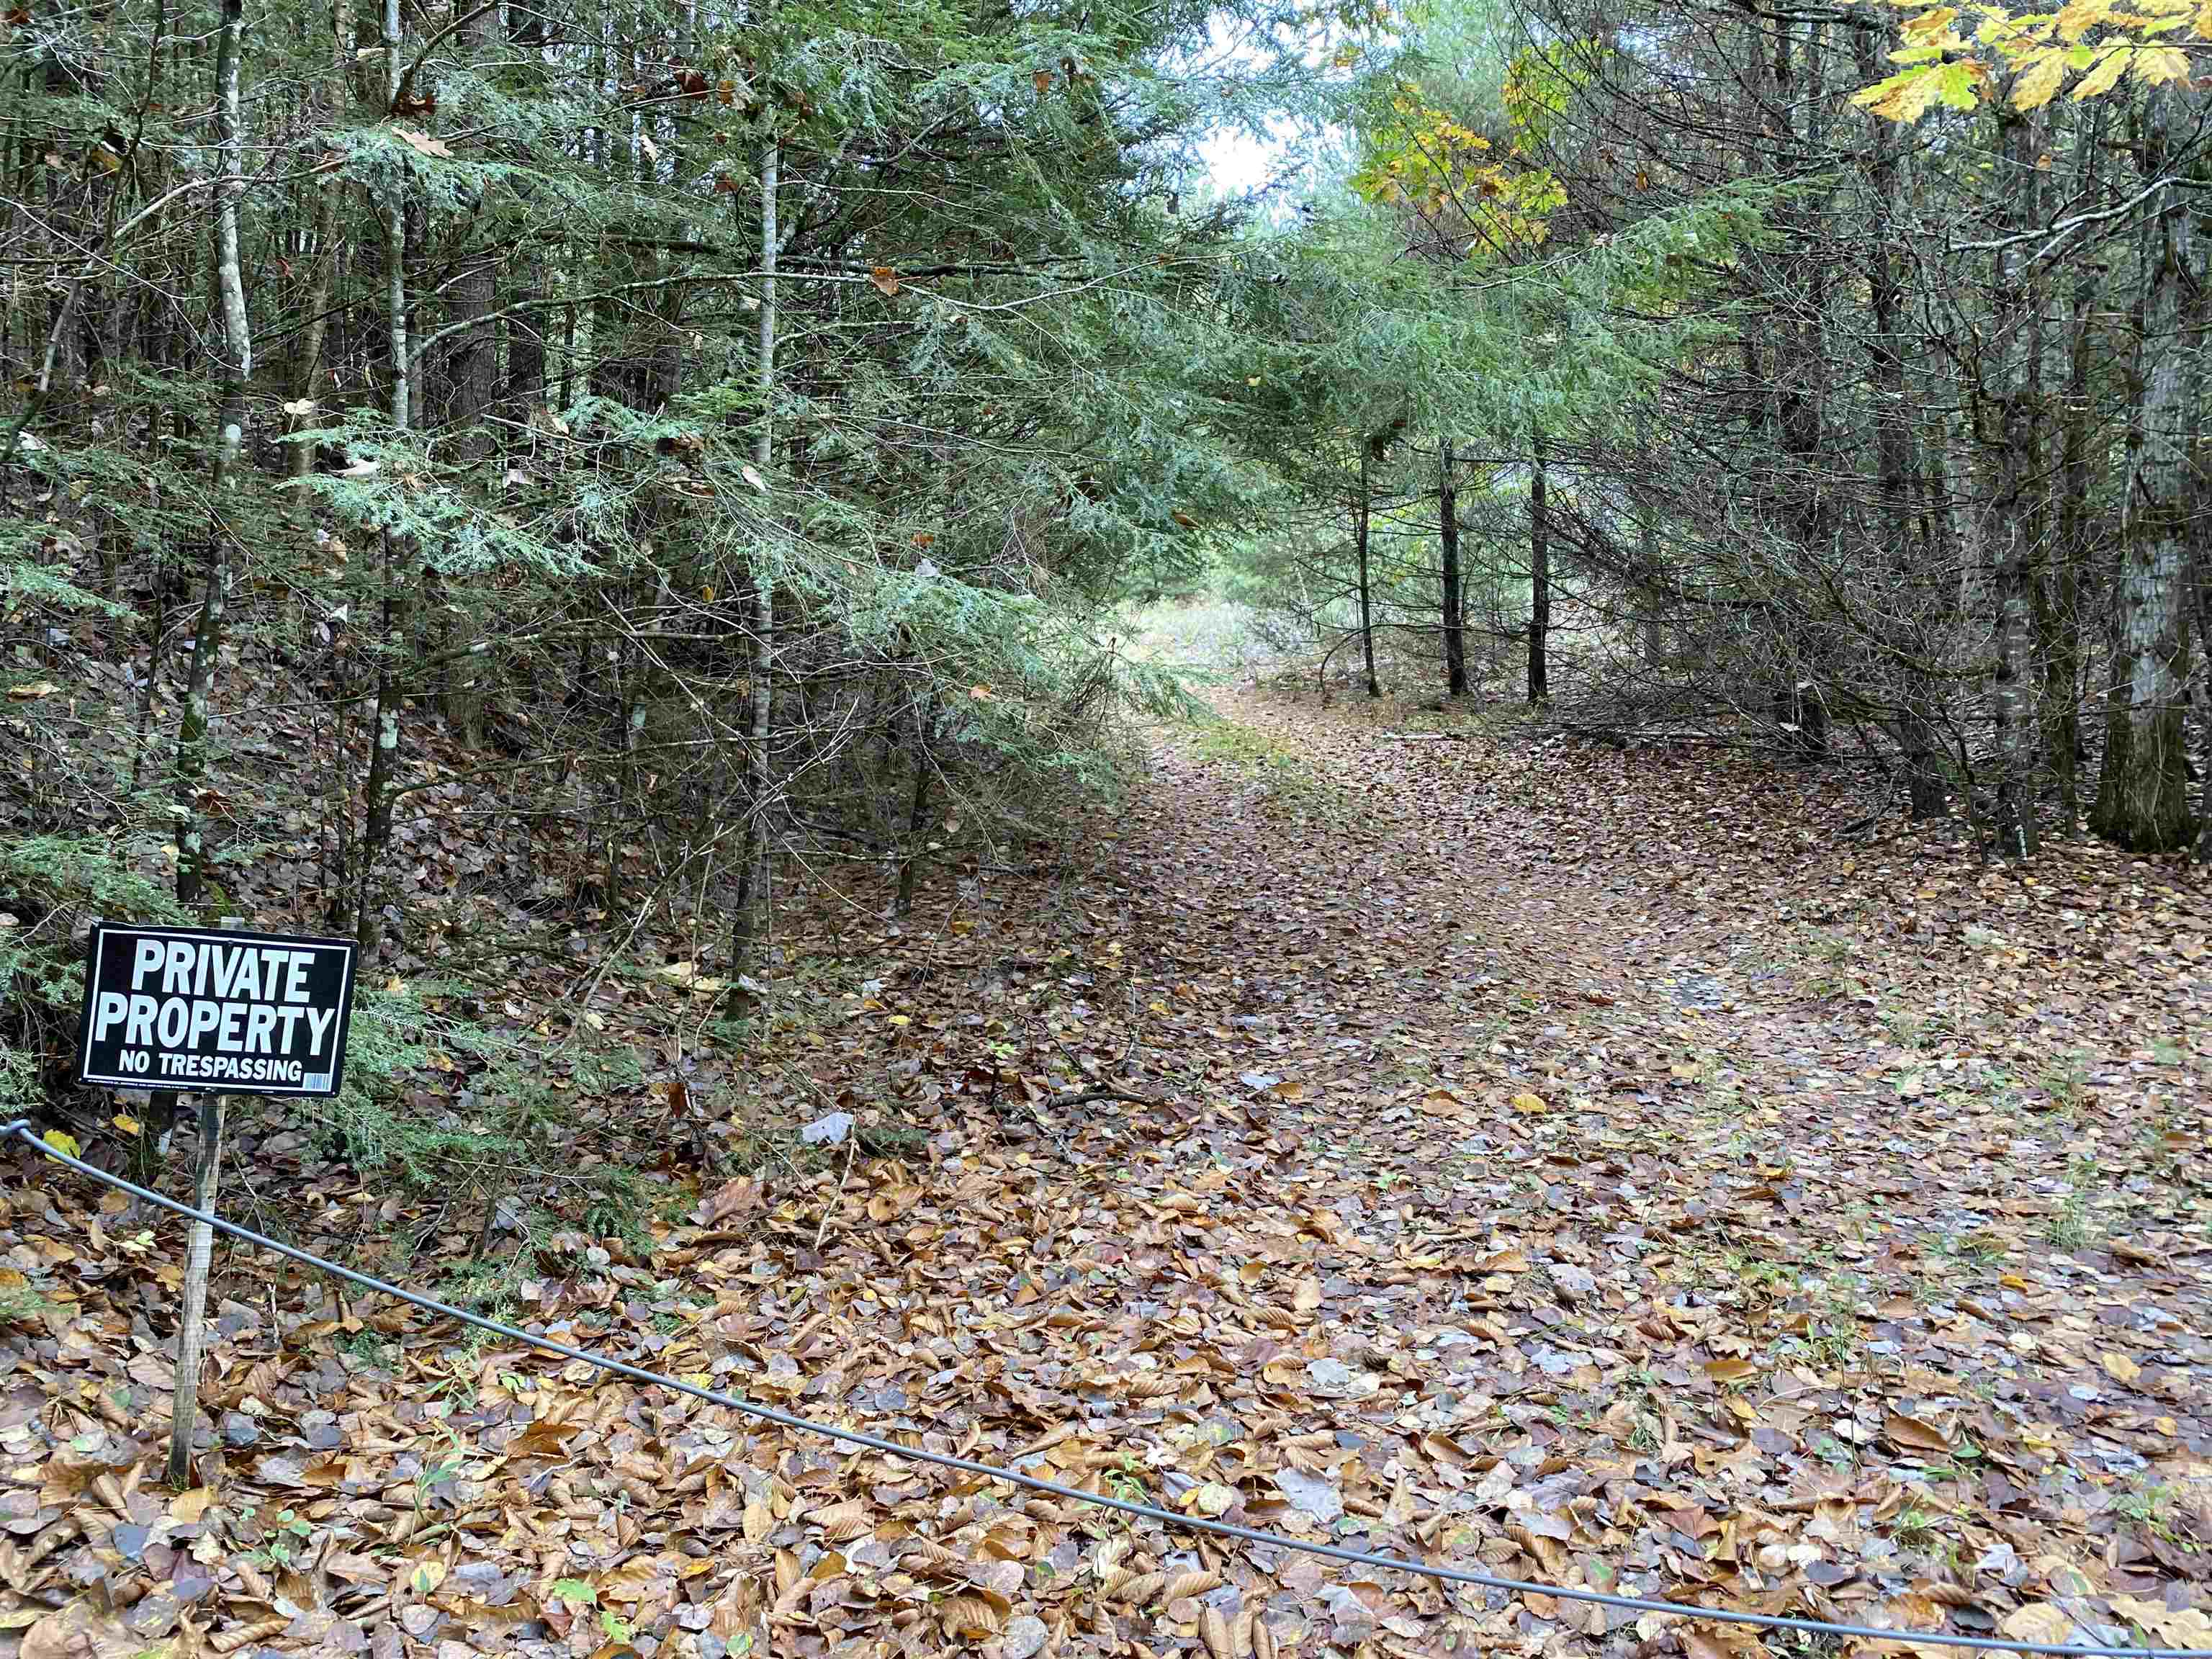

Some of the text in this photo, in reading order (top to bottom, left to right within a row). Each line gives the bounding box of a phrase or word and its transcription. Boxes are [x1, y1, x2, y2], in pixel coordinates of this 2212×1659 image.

[131, 938, 315, 1003] PRIVATE
[95, 992, 336, 1056] PROPERTY
[119, 1049, 302, 1082] NO TRESPASSING
